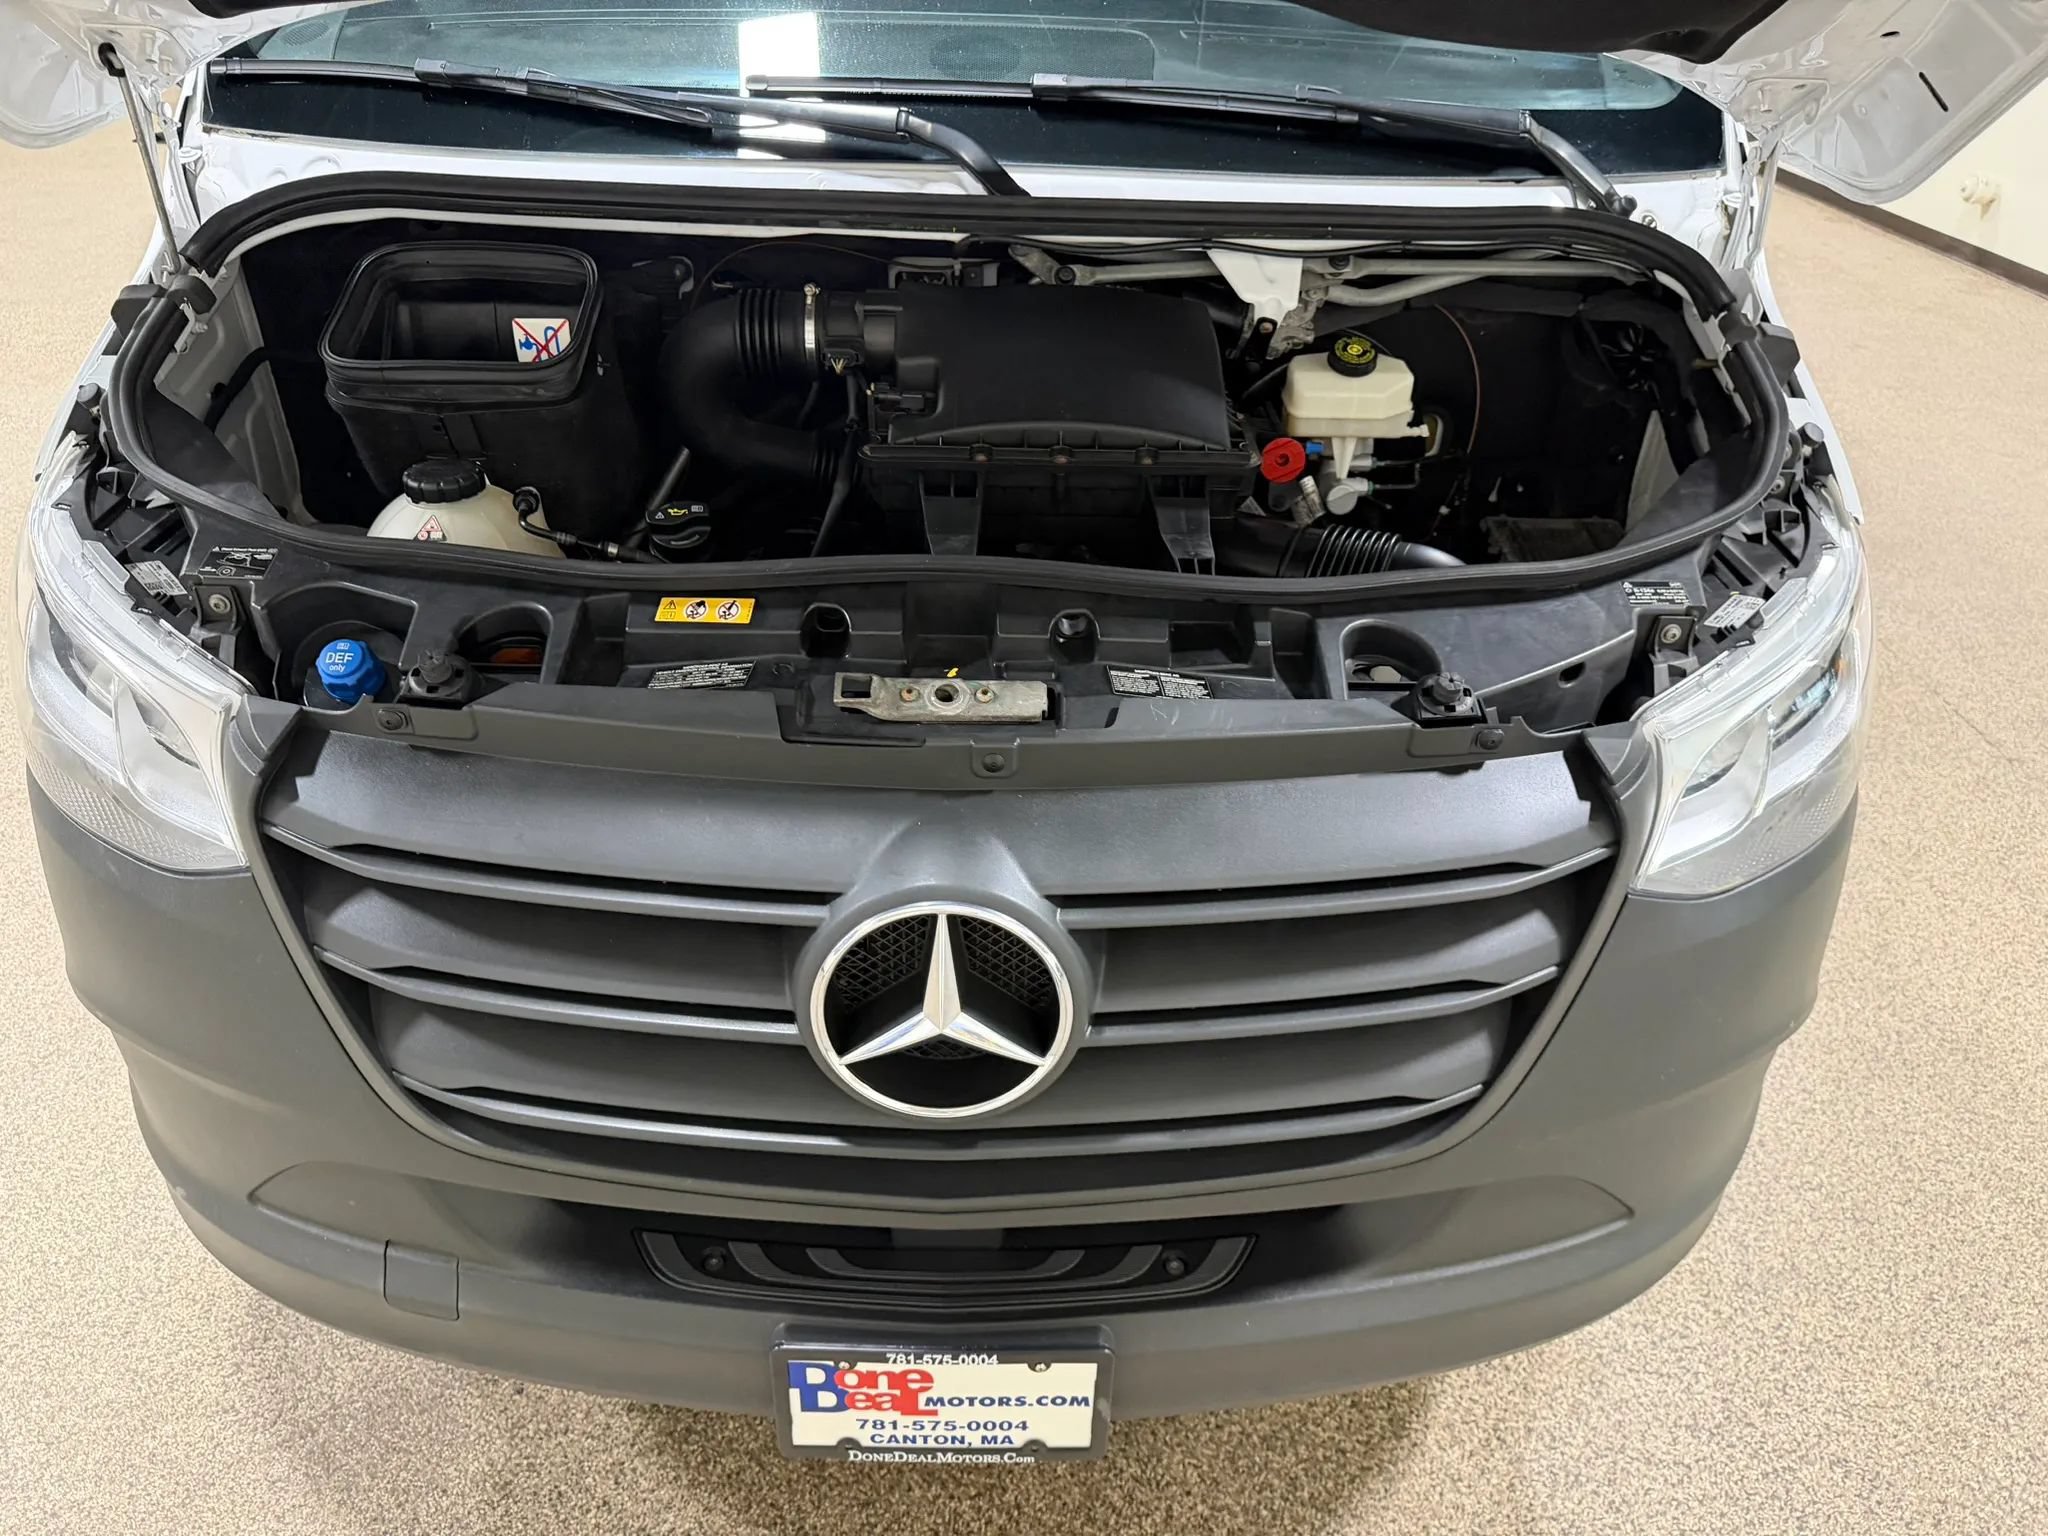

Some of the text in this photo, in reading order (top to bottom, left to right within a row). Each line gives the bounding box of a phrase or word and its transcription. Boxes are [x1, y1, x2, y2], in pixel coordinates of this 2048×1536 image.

[325, 652, 354, 663] DEF
[329, 664, 346, 672] only
[886, 1353, 1000, 1365] 781-575-0004
[924, 1395, 1090, 1407] MOTORS.COM
[856, 1419, 1029, 1431] 781-575-0004
[870, 1433, 1014, 1447] CANTON, MA
